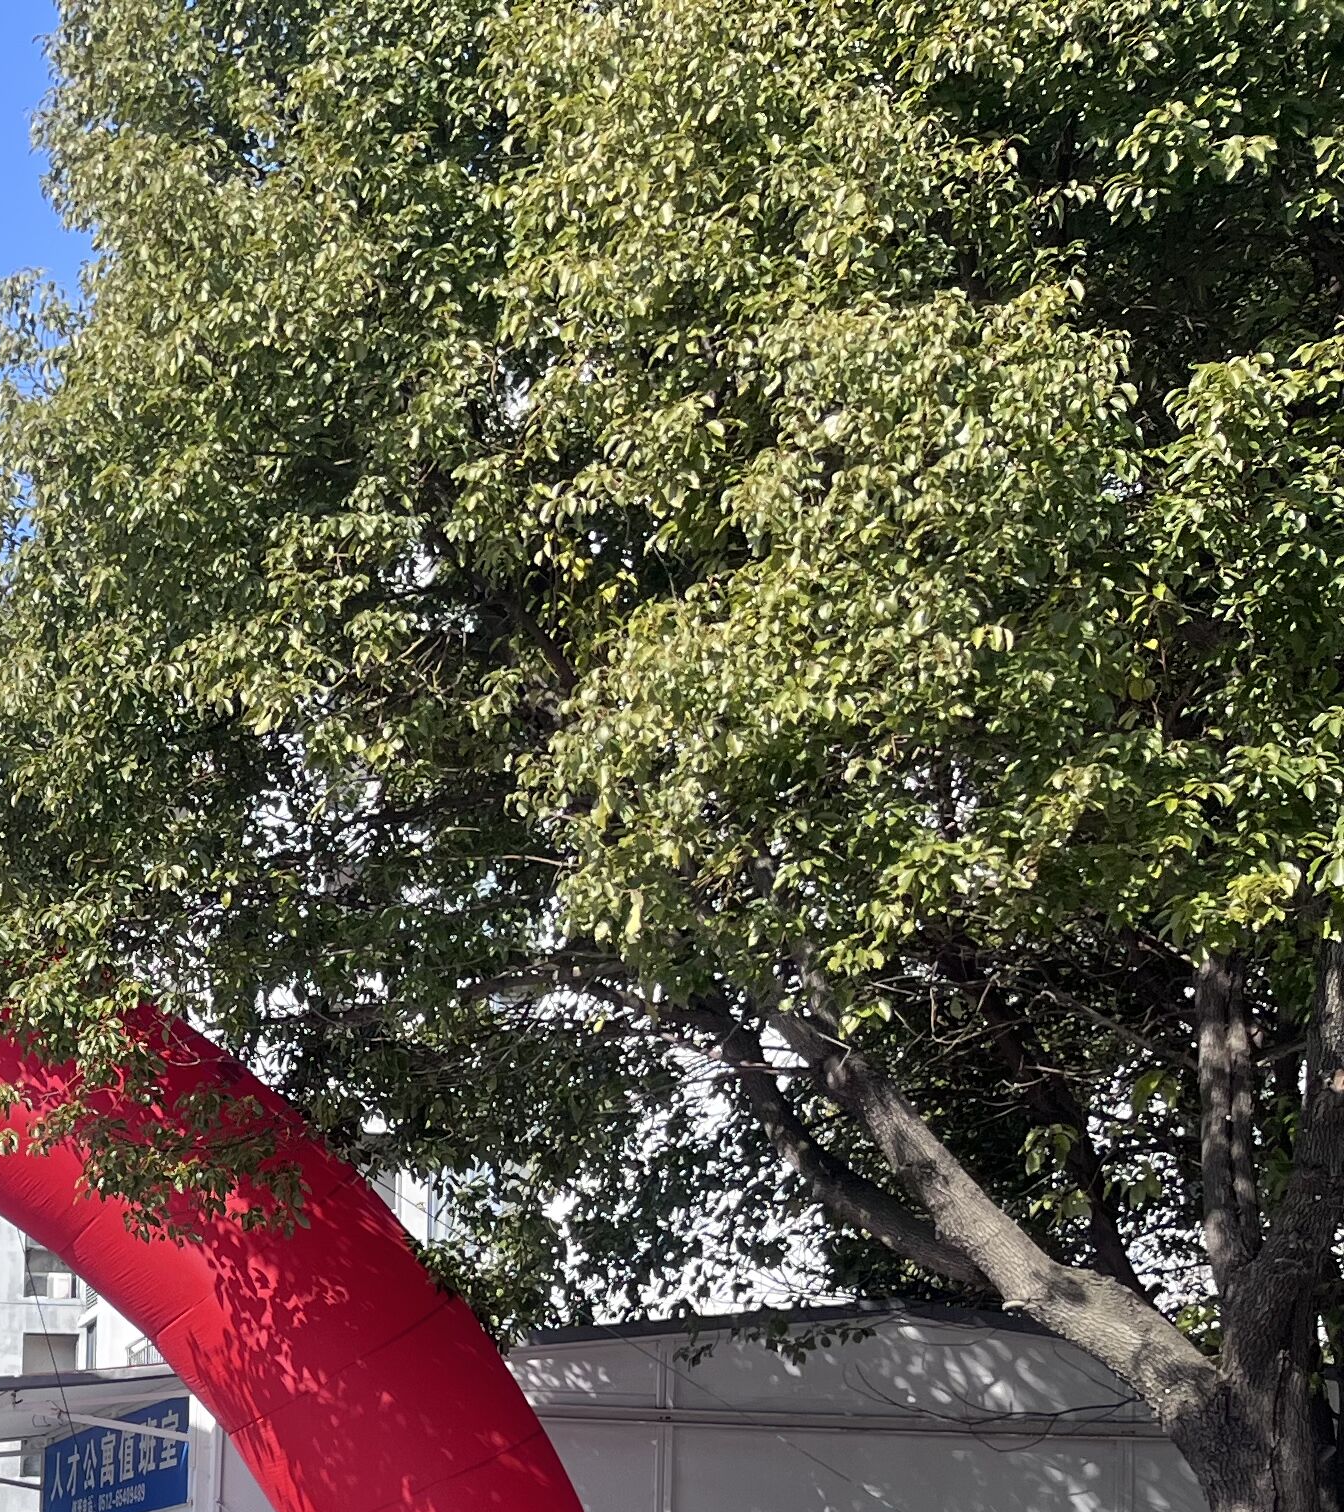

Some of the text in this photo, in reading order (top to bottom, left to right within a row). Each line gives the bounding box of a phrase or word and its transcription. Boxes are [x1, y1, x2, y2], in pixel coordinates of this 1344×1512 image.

[50, 1409, 180, 1501] 人才公寓值班室
